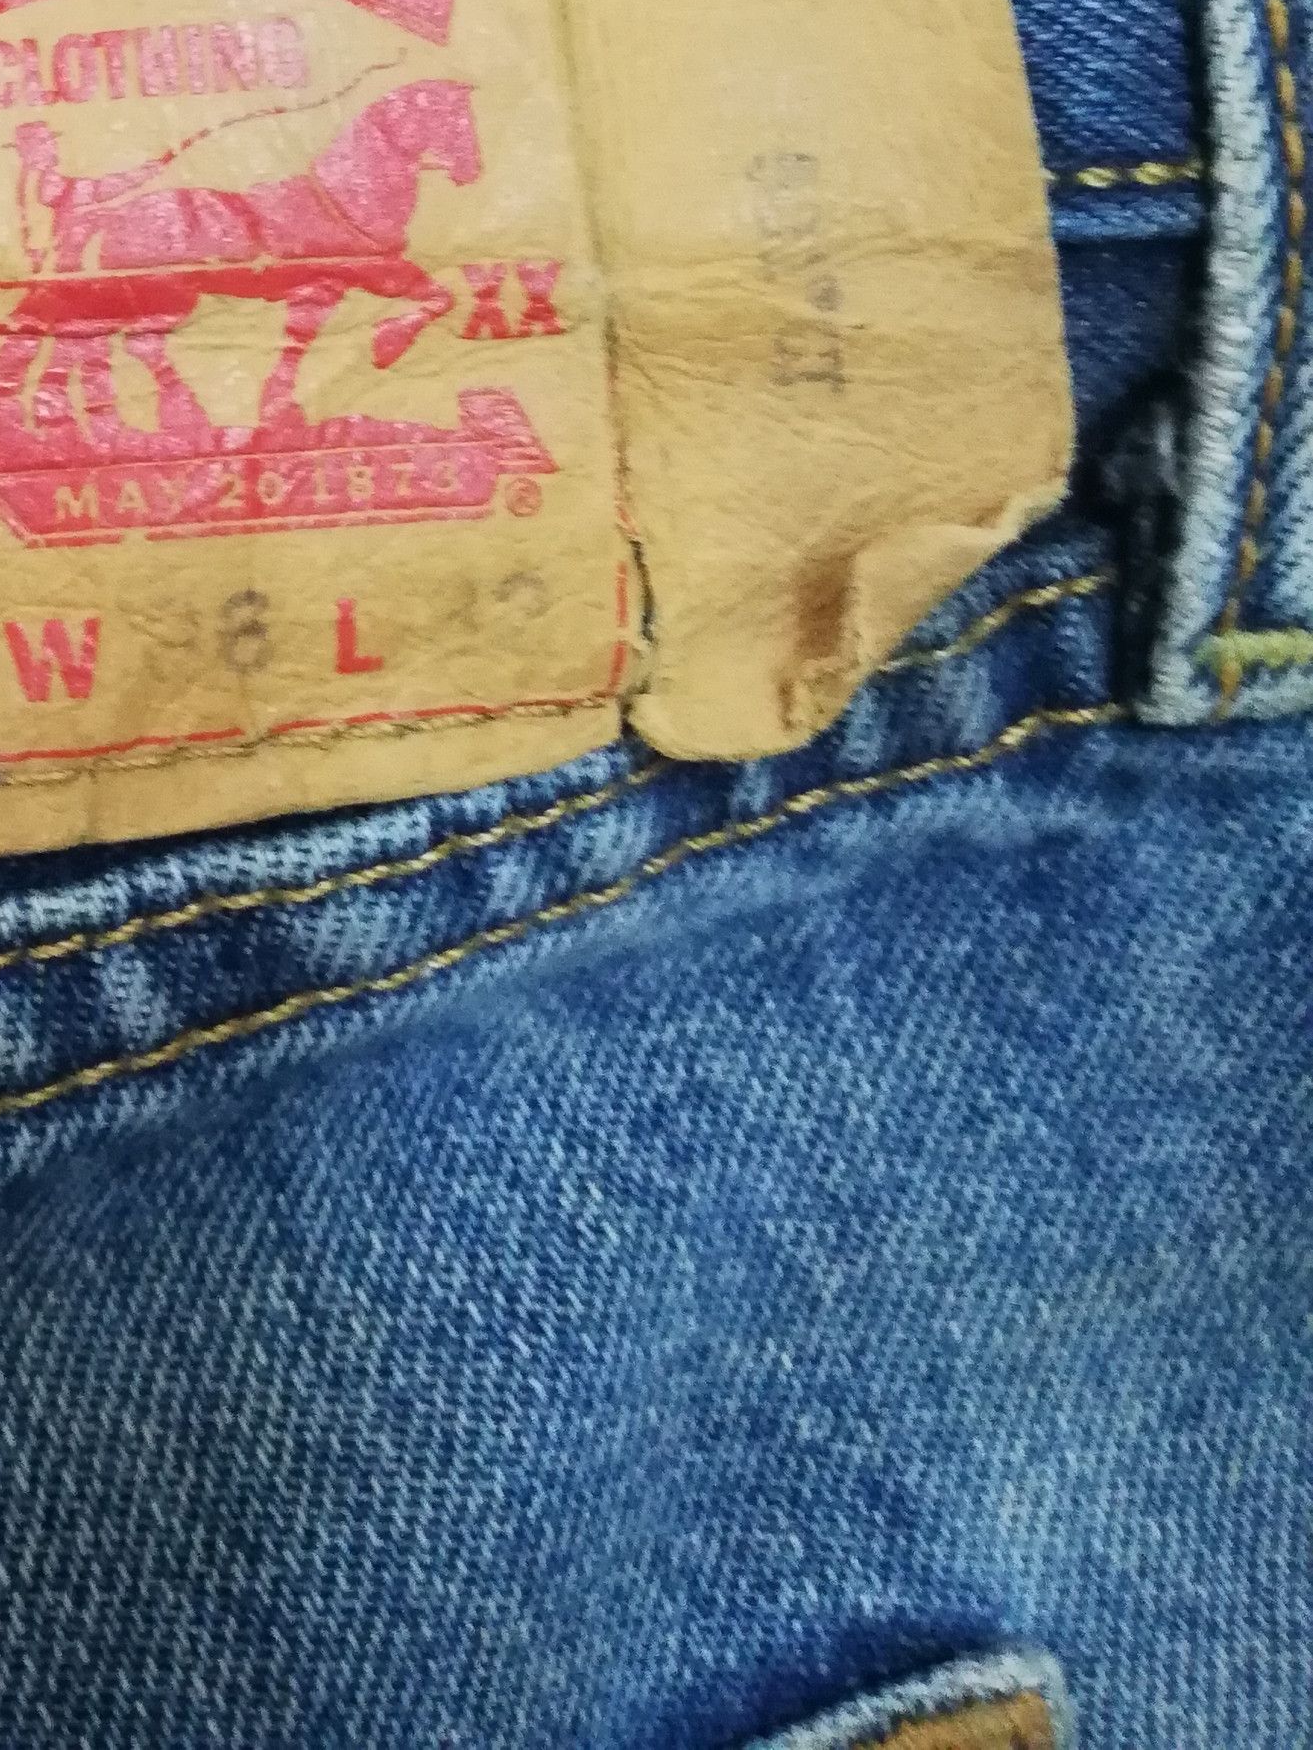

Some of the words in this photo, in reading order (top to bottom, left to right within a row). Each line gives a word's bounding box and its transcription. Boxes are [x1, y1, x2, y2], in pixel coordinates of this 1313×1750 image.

[457, 259, 568, 340] XX
[52, 479, 184, 523] MAY
[217, 469, 288, 511] 20
[310, 459, 464, 503] 1873
[3, 616, 102, 703] W
[333, 597, 385, 675] L
